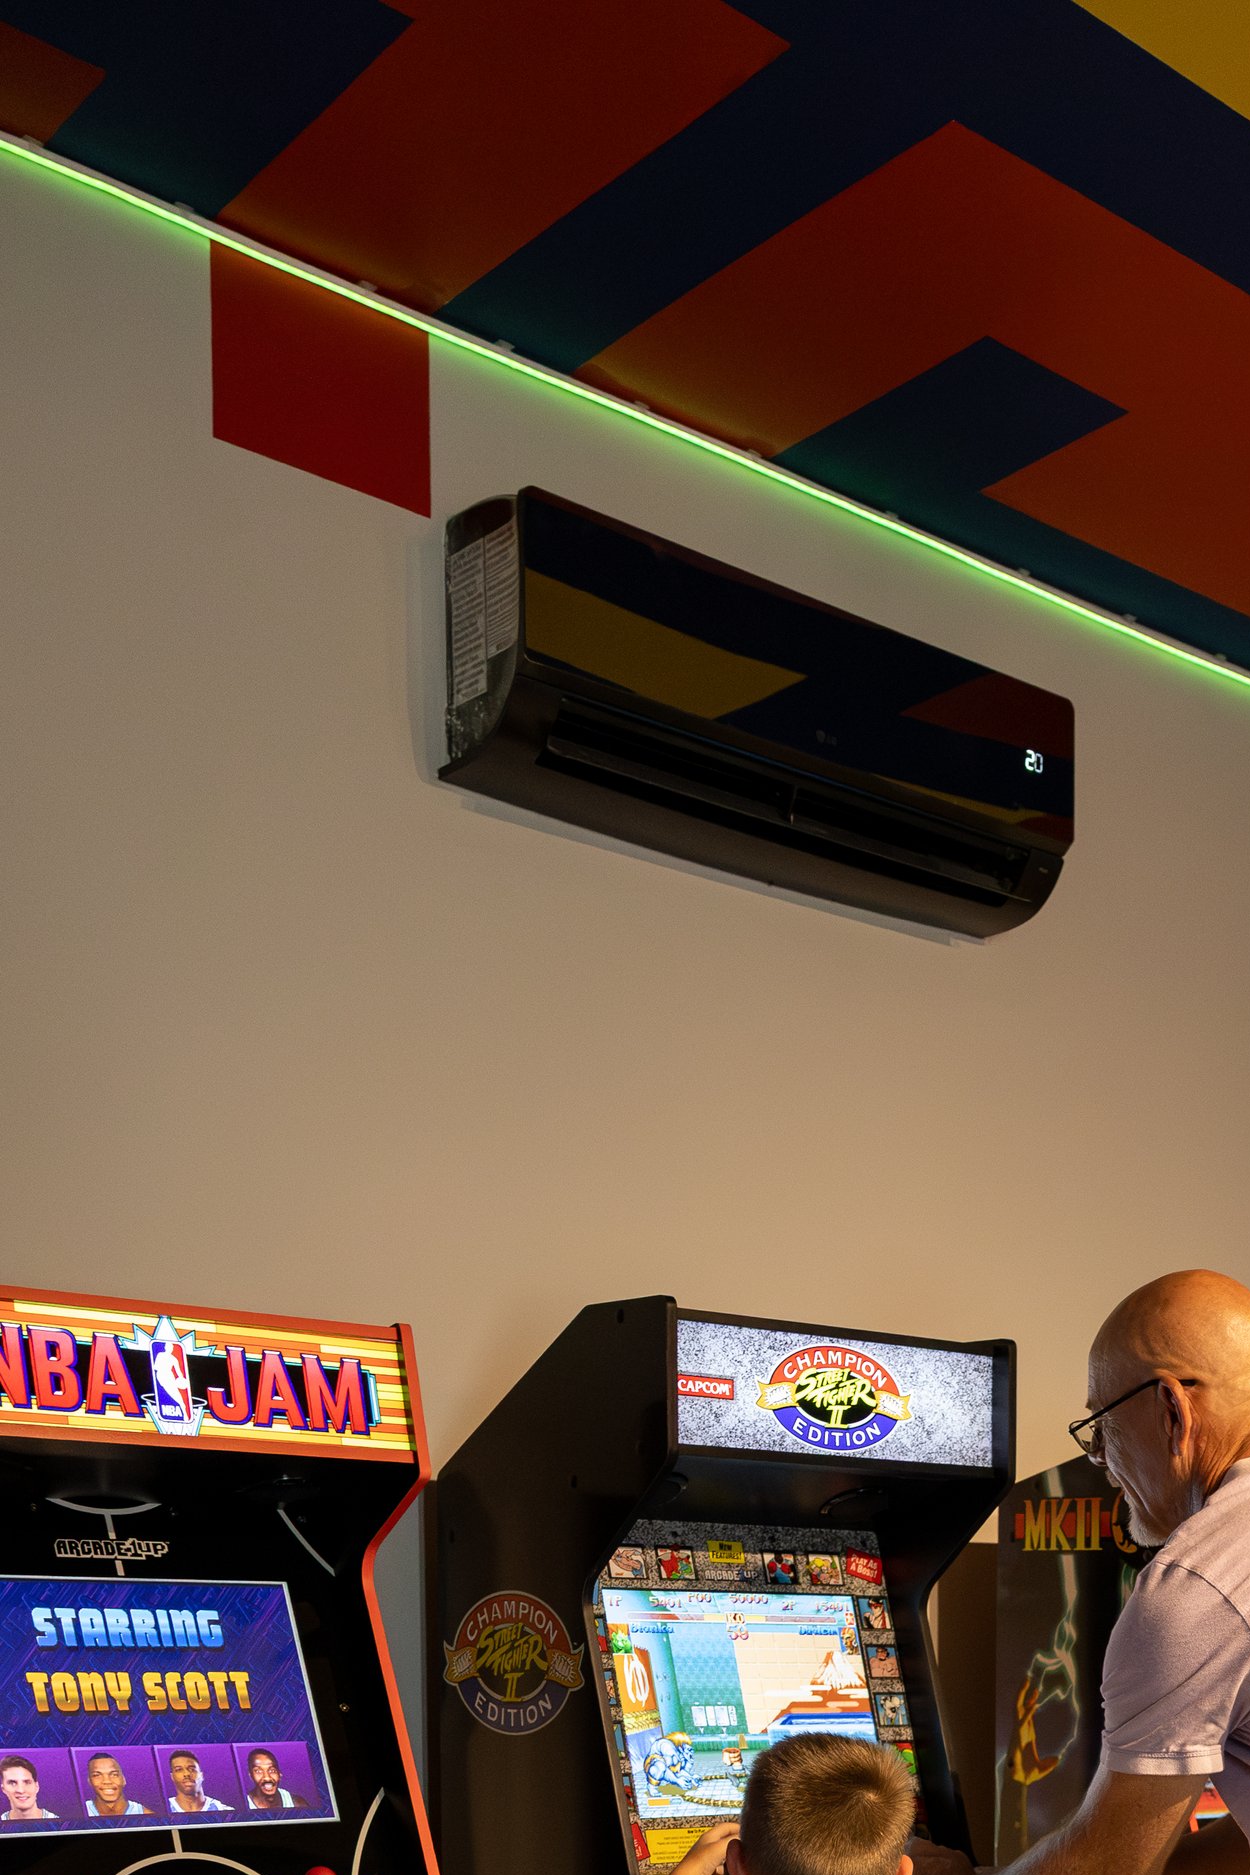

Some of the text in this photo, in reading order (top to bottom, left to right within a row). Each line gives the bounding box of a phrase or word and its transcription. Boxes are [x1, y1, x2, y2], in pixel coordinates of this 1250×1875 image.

[1025, 749, 1043, 773] 20
[677, 1378, 731, 1396] CAPCOM
[782, 1350, 888, 1388] CHAMPION
[796, 1367, 852, 1401] STREET
[207, 1345, 371, 1435] JAM
[804, 1376, 877, 1408] FIGHTER
[161, 1404, 183, 1418] NBA
[792, 1417, 882, 1447] EDITION
[1022, 1497, 1104, 1551] MKII
[31, 1607, 225, 1650] STARRING
[466, 1600, 558, 1645] CHAMPION
[476, 1622, 523, 1671] STREET
[485, 1633, 549, 1676] FIGHTER
[25, 1671, 252, 1714] TONY SCOTT
[474, 1691, 553, 1728] EDITION
